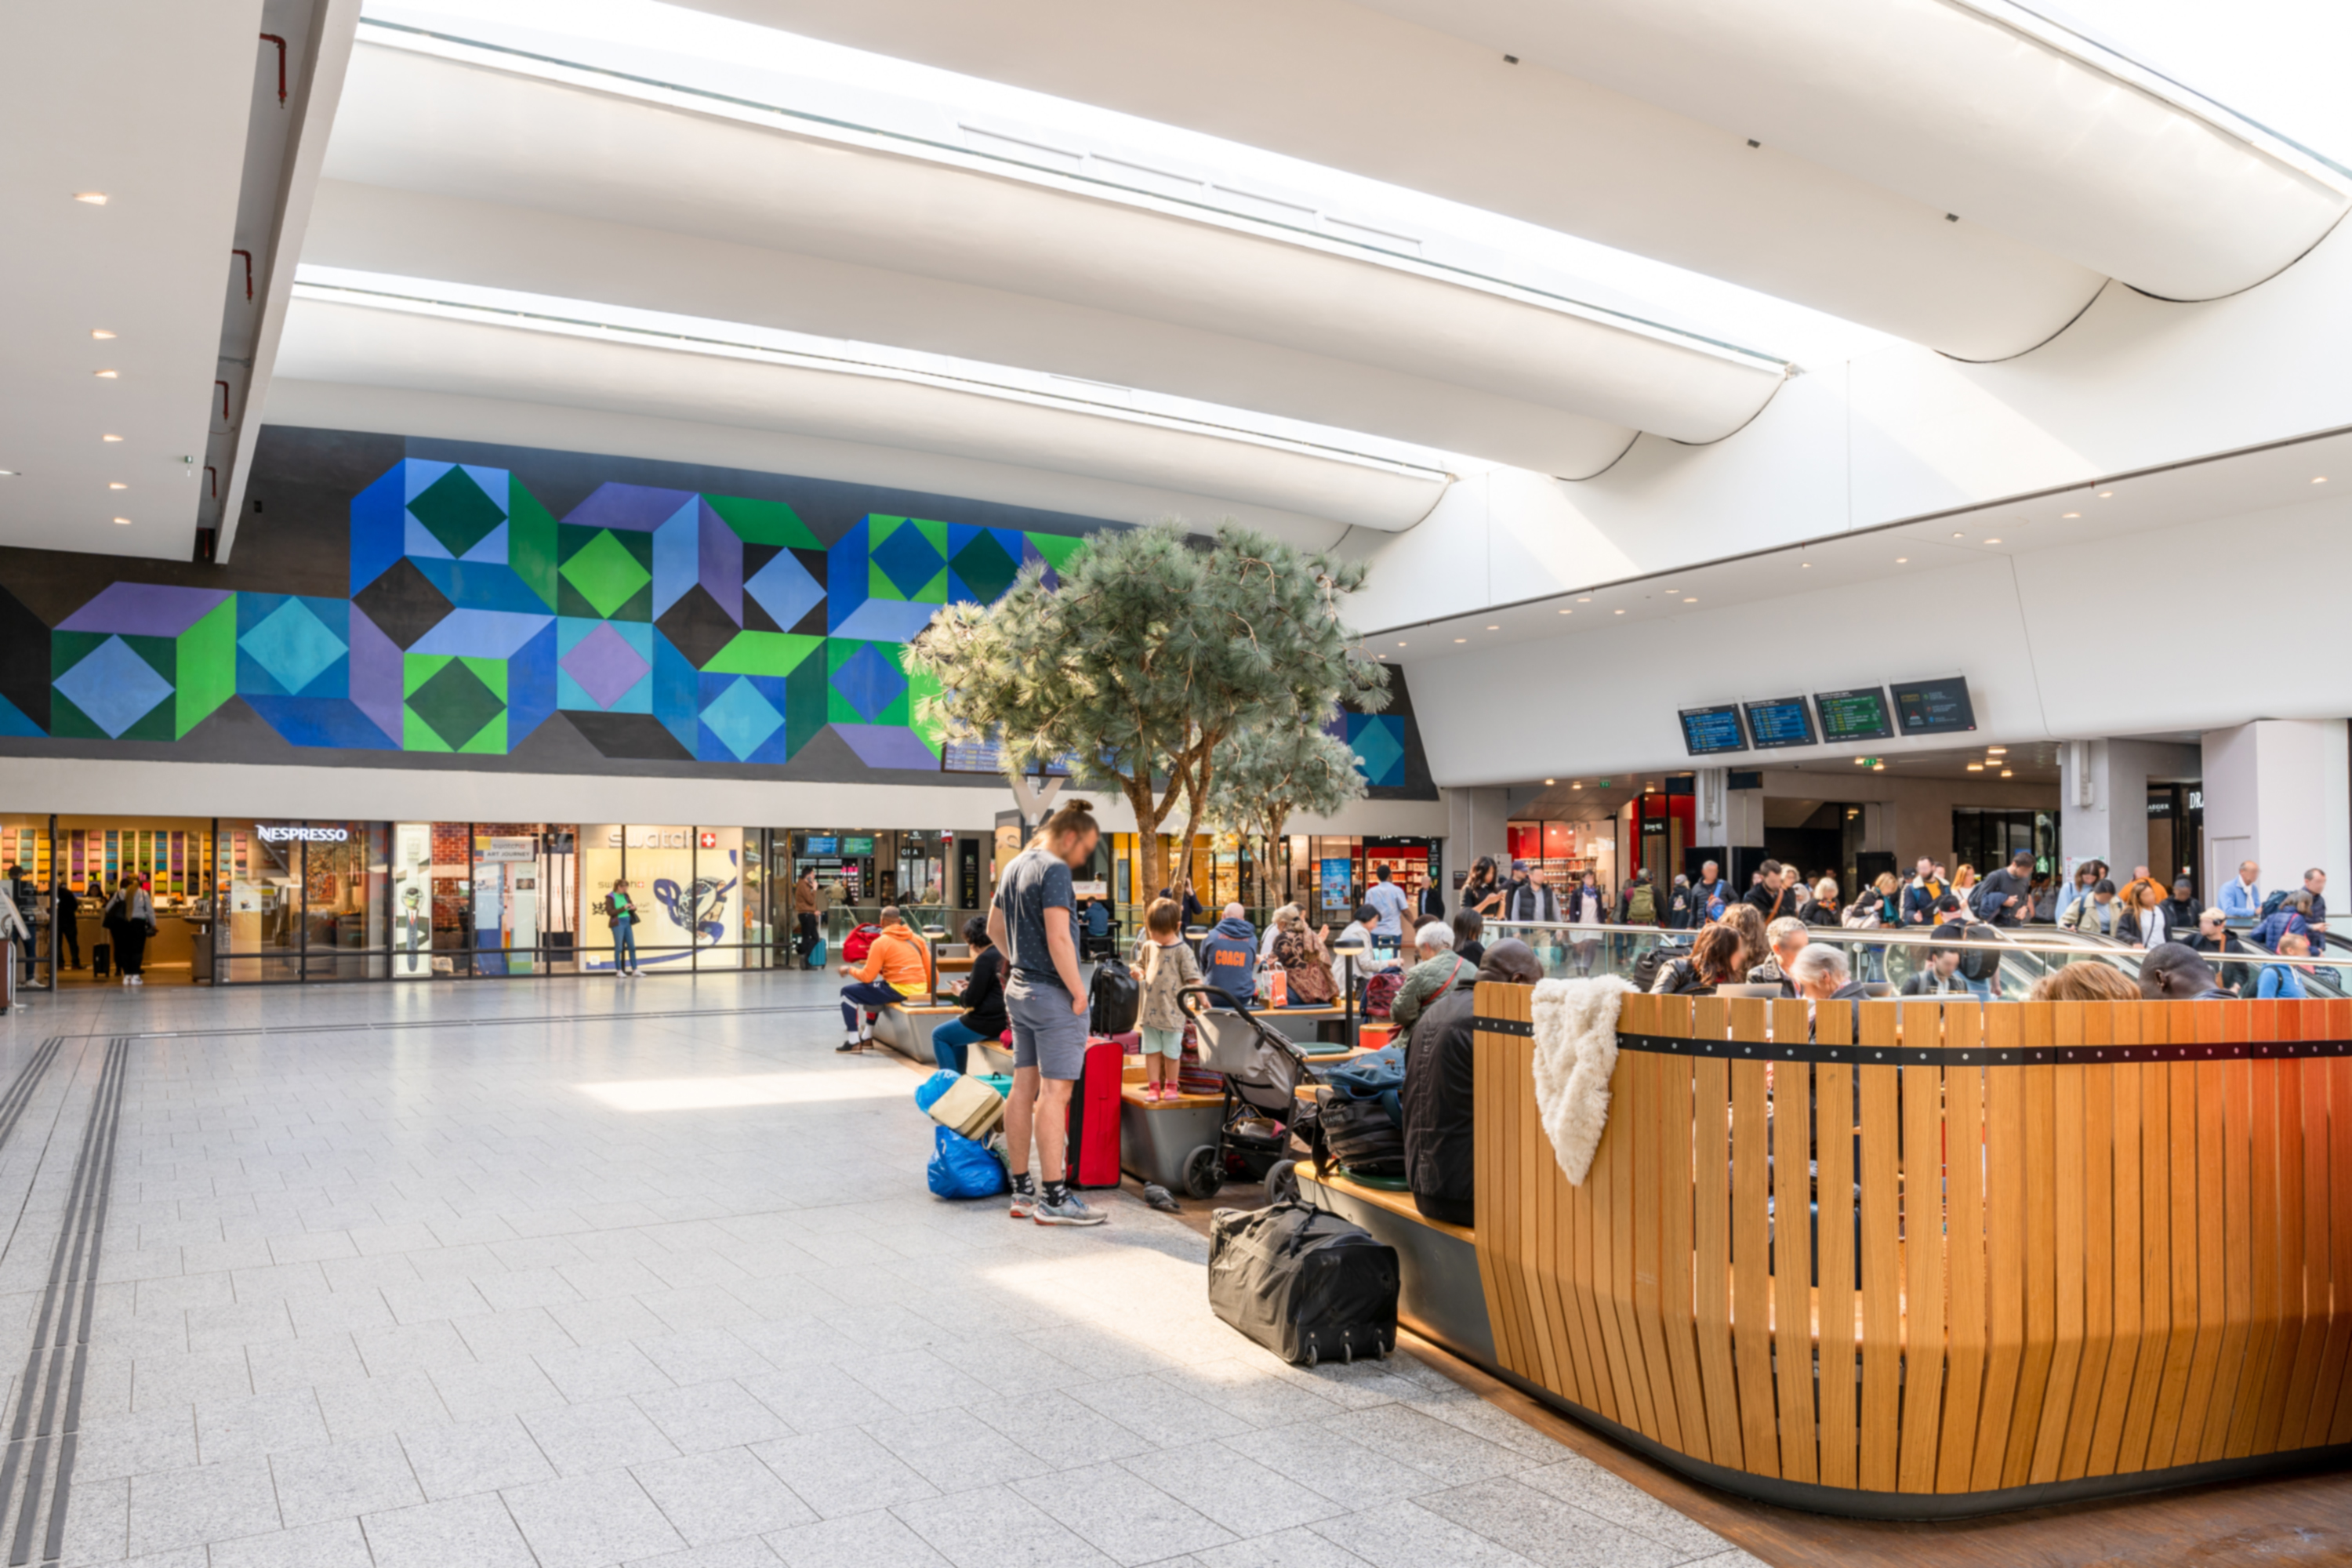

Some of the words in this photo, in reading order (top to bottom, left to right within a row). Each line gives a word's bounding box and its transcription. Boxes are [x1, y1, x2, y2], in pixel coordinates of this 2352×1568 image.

[254, 824, 348, 843] NESPRESSO
[608, 830, 700, 848] swatch
[1214, 949, 1247, 967] COACH
